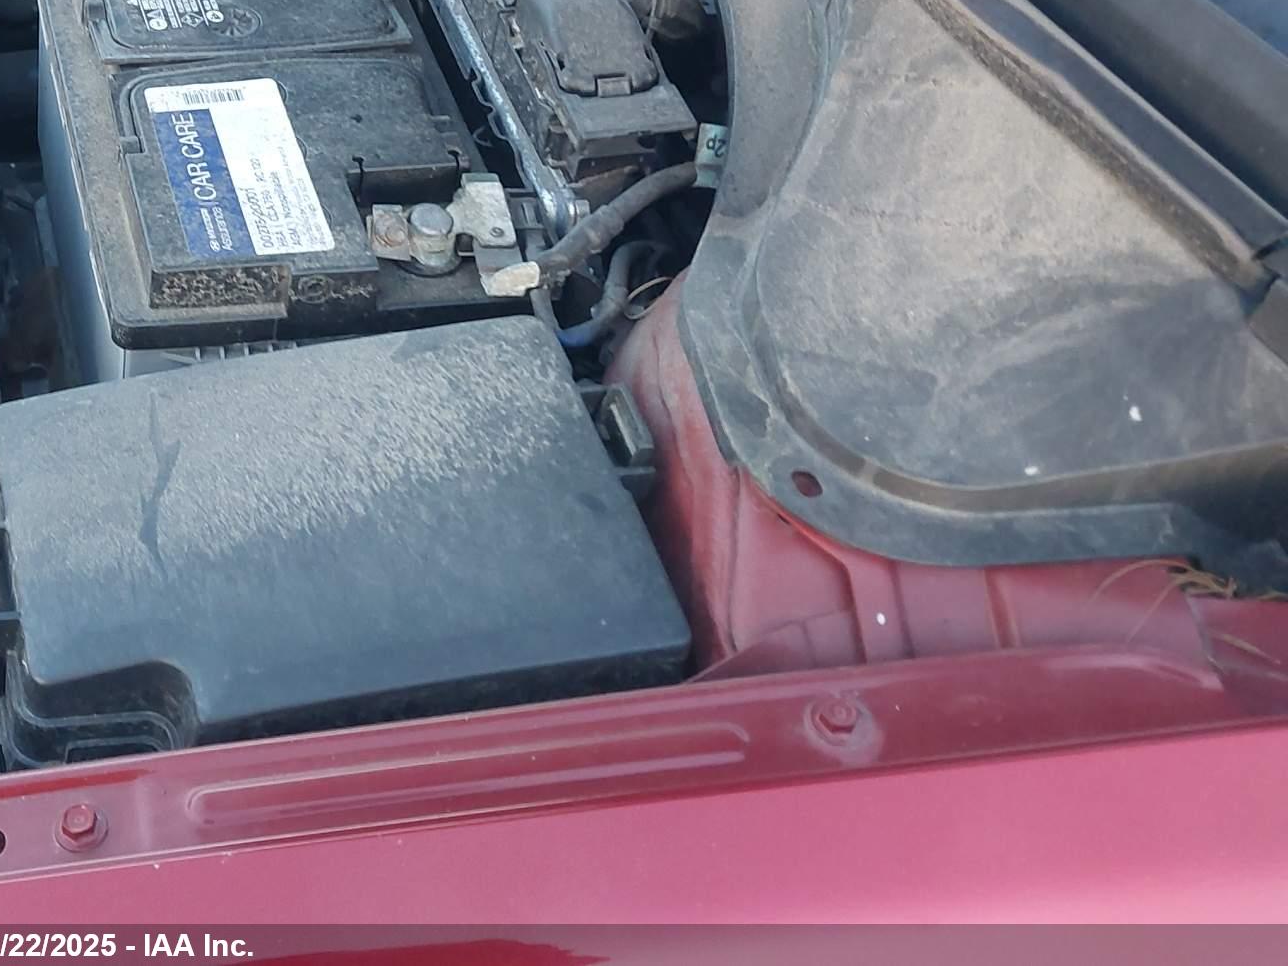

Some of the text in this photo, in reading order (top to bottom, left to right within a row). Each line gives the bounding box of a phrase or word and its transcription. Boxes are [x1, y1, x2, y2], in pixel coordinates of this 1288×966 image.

[171, 111, 217, 201] CAR CARE
[211, 206, 234, 251] Assurance
